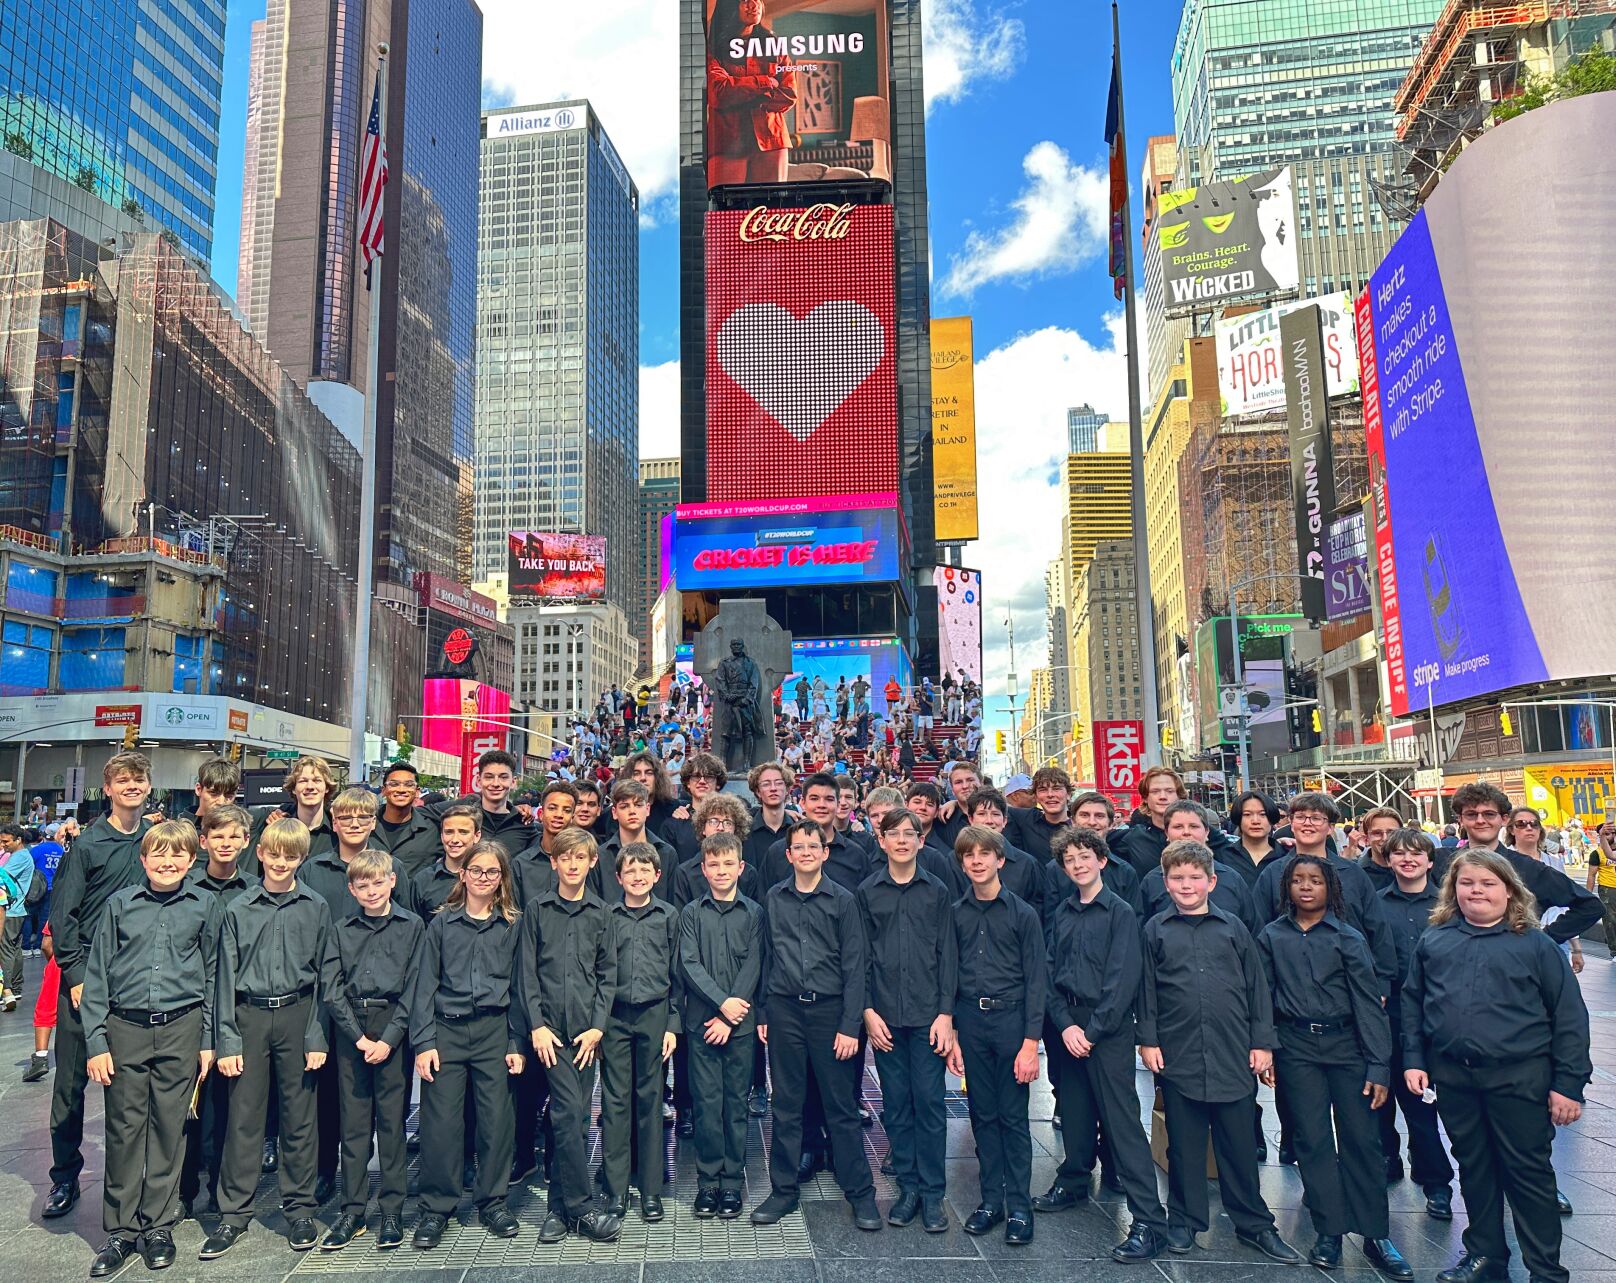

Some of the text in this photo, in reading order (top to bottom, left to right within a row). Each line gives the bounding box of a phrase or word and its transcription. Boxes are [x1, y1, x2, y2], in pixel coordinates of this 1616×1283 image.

[729, 32, 864, 59] SAMSUNG
[775, 63, 818, 75] presents
[499, 116, 552, 133] Allianz
[1172, 242, 1251, 266] Brains. Heart.
[1187, 256, 1238, 273] Courage.
[1377, 262, 1406, 312] Hertz
[1381, 295, 1412, 344] makes
[1384, 305, 1437, 375] checkout a
[1358, 304, 1381, 434] CHOCOLATE
[1387, 334, 1446, 408] smooth ride
[1292, 338, 1314, 431] boohooMAN
[951, 396, 958, 404] &
[1390, 378, 1445, 441] with Stripe.
[940, 423, 949, 431] IN
[933, 435, 967, 445] AILAND
[1302, 441, 1323, 534] GUNNA
[693, 508, 722, 516] TICKETS
[734, 503, 808, 514] T20WORLDCUP.COM
[518, 558, 596, 572] TAKE YOU BACK
[693, 540, 879, 571] CRICKET IS HERE
[1379, 541, 1398, 612] COME
[1246, 623, 1295, 633] Pick me.
[1413, 653, 1490, 687] stripe Make progress
[187, 713, 210, 721] OPEN
[1106, 724, 1139, 788] tkts
[260, 786, 283, 794] NOPE
[45, 857, 60, 869] 33
